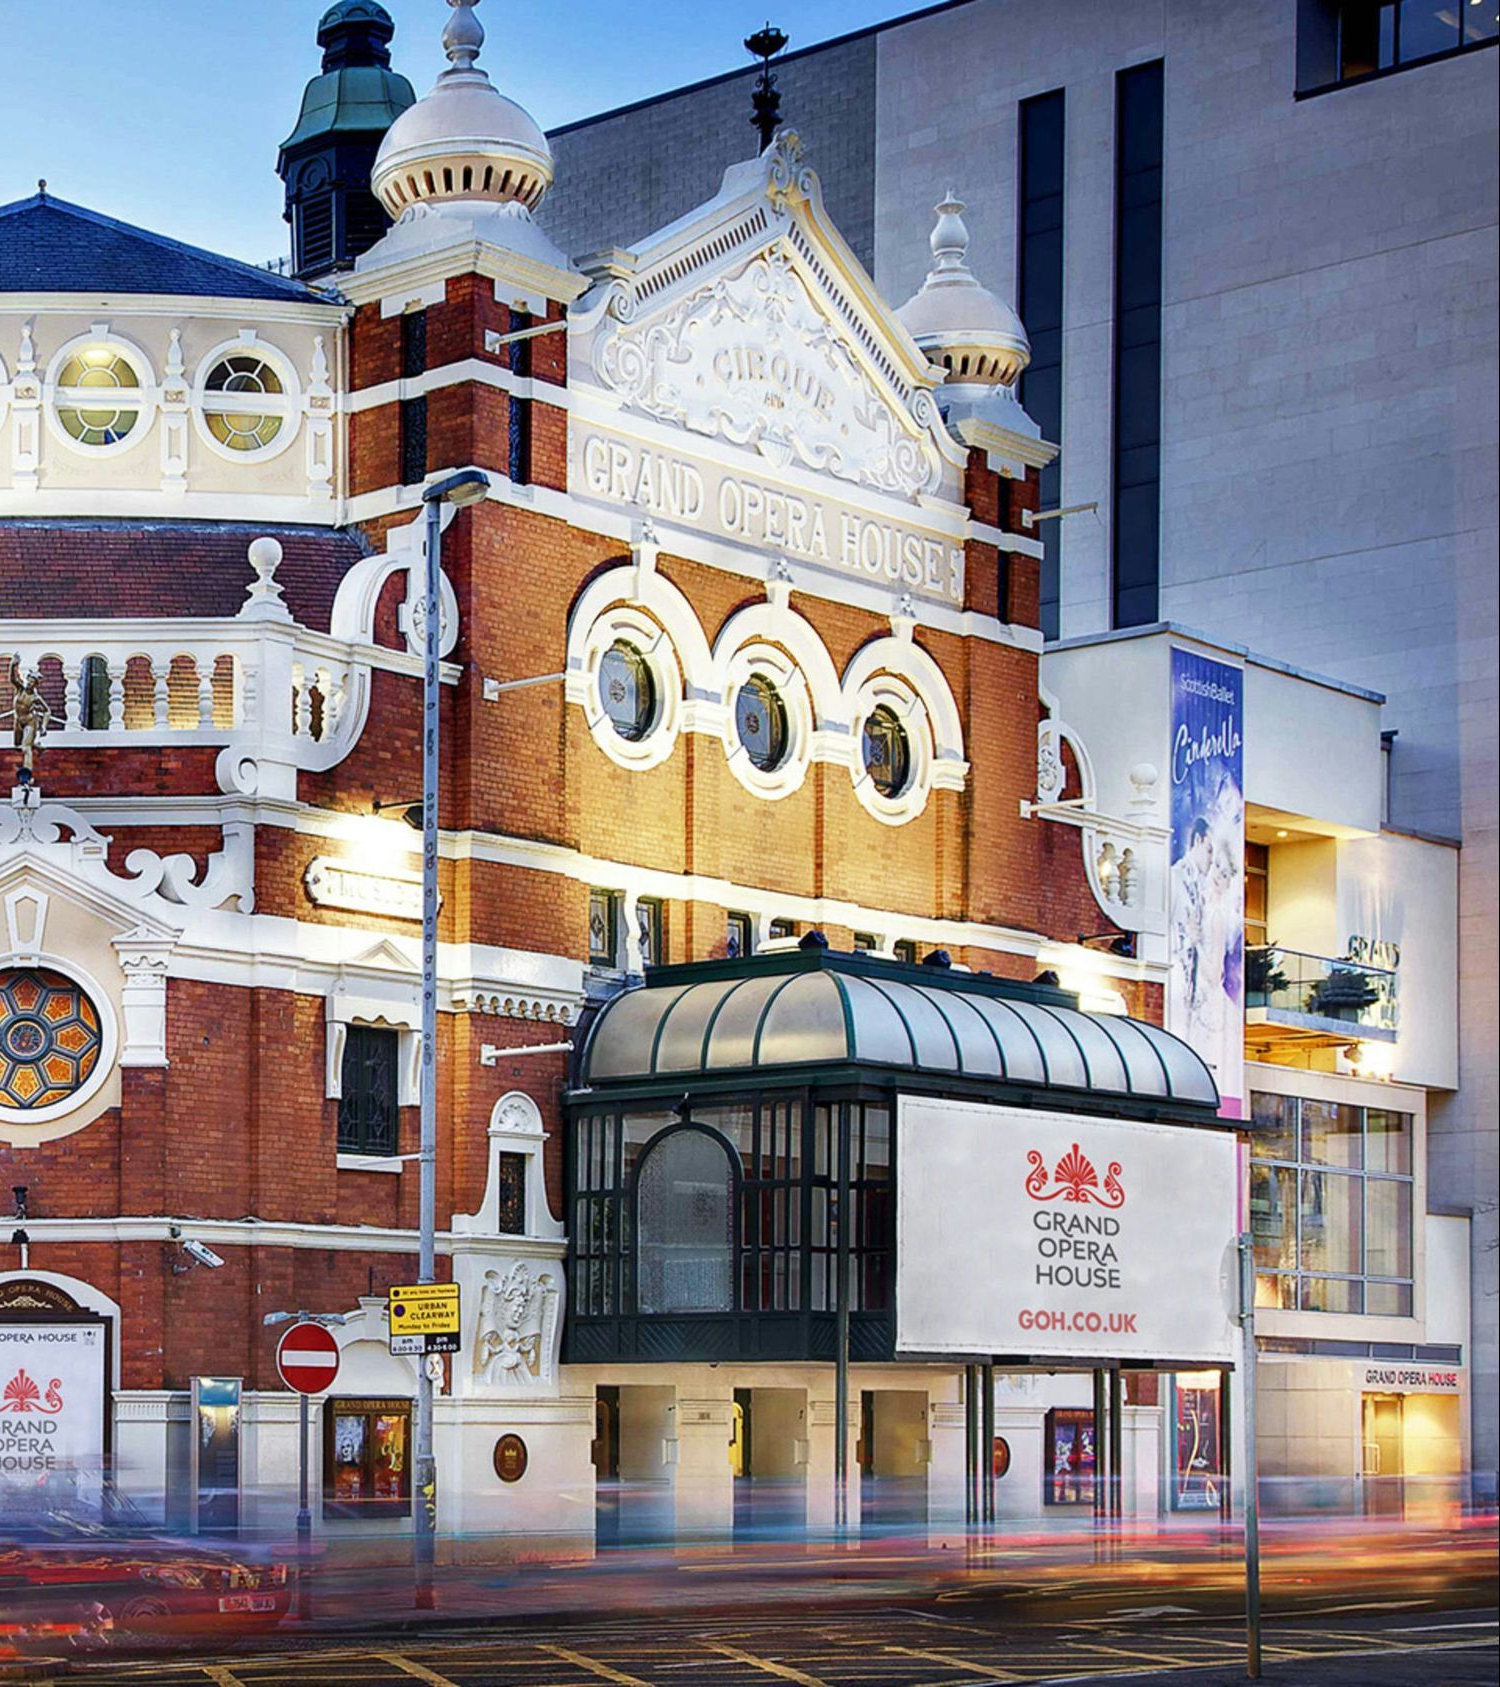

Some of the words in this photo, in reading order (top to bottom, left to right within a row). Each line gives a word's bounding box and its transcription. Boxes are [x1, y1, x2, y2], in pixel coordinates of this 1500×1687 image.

[712, 345, 835, 423] CIRQUE
[584, 435, 704, 522] GRAND
[719, 477, 831, 560] OPERA
[840, 512, 945, 592] HOUSE
[1173, 714, 1242, 784] Cinderella
[1033, 1210, 1120, 1238] GRAND
[1038, 1237, 1118, 1266] OPERA
[1036, 1264, 1121, 1289] HOUSE
[8, 1285, 41, 1295] OPERA
[45, 1289, 75, 1313] HOUSE
[417, 1301, 448, 1311] URBAN
[410, 1311, 456, 1321] CLEARWAY
[1018, 1309, 1138, 1333] GOH.CO.UK
[38, 1333, 77, 1342] HOUSE
[1365, 1369, 1396, 1384] GRAND
[1398, 1370, 1427, 1386] OPERA
[1428, 1371, 1457, 1387] HOUSE
